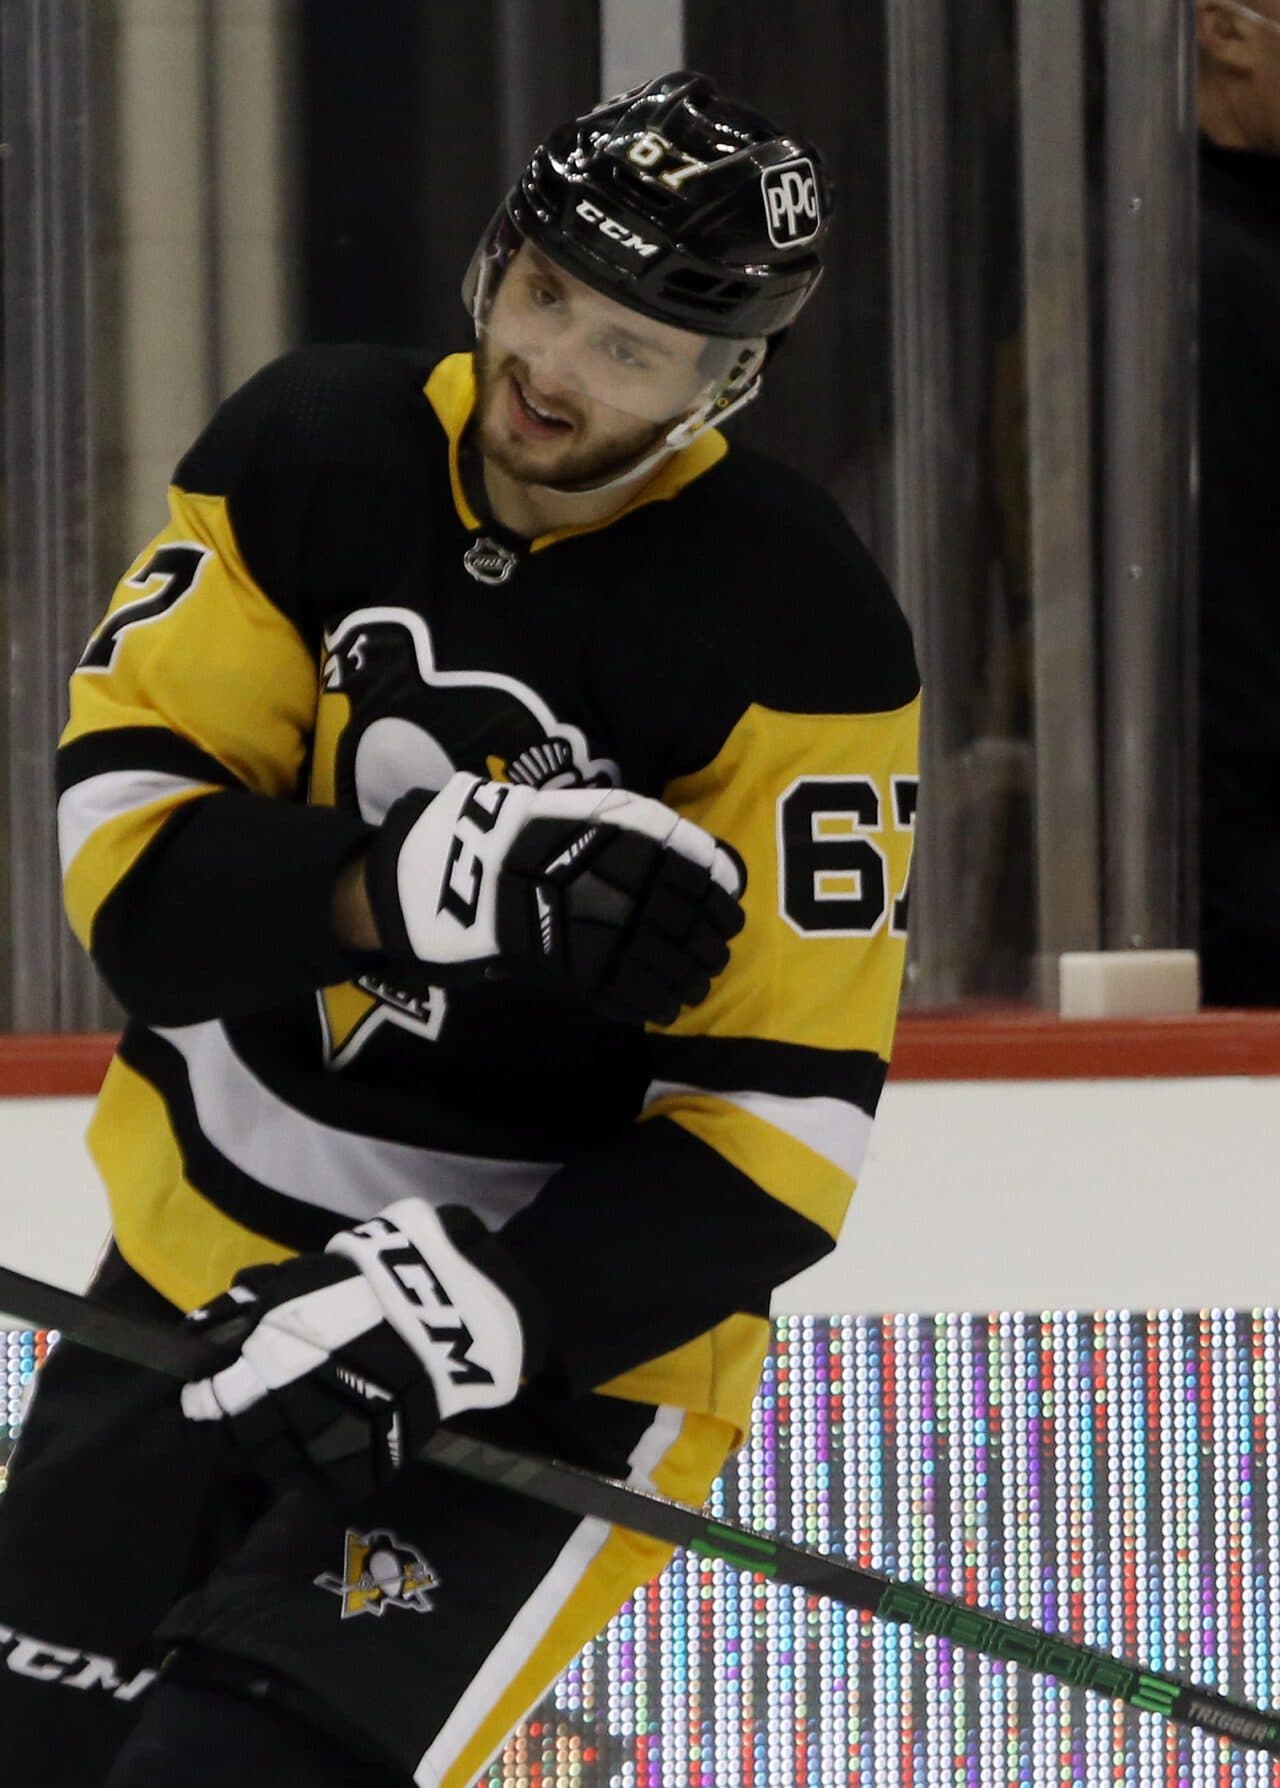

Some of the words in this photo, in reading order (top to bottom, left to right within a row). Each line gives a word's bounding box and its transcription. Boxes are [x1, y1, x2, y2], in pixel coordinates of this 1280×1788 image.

[624, 129, 708, 191] 67
[575, 199, 659, 258] CCM
[767, 171, 818, 236] PPG
